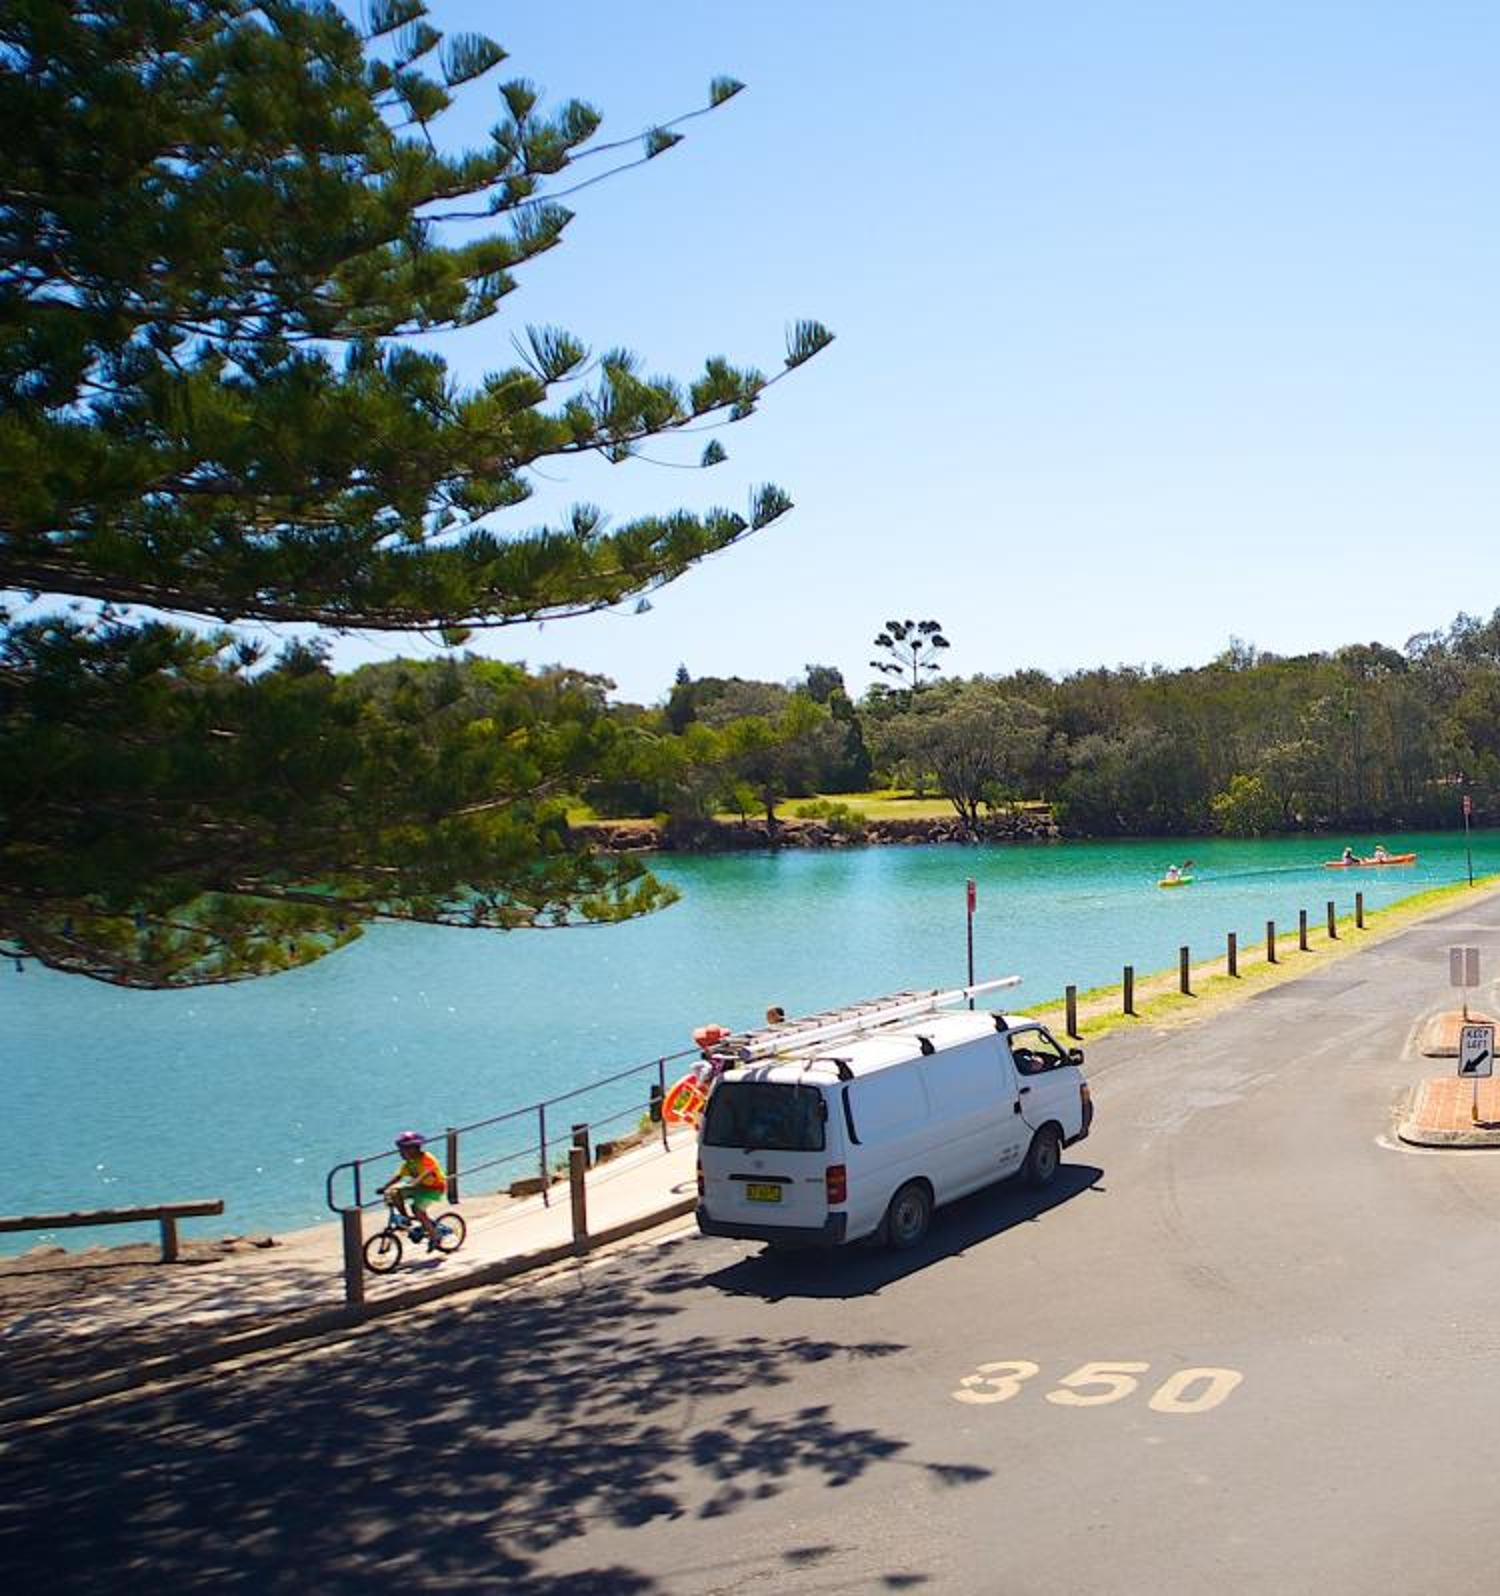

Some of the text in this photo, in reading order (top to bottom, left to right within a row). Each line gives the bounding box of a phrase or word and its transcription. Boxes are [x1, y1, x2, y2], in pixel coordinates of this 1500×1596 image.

[1467, 1030, 1489, 1039] KEEP
[1467, 1039, 1487, 1048] LEFT
[951, 1361, 1243, 1413] 350
